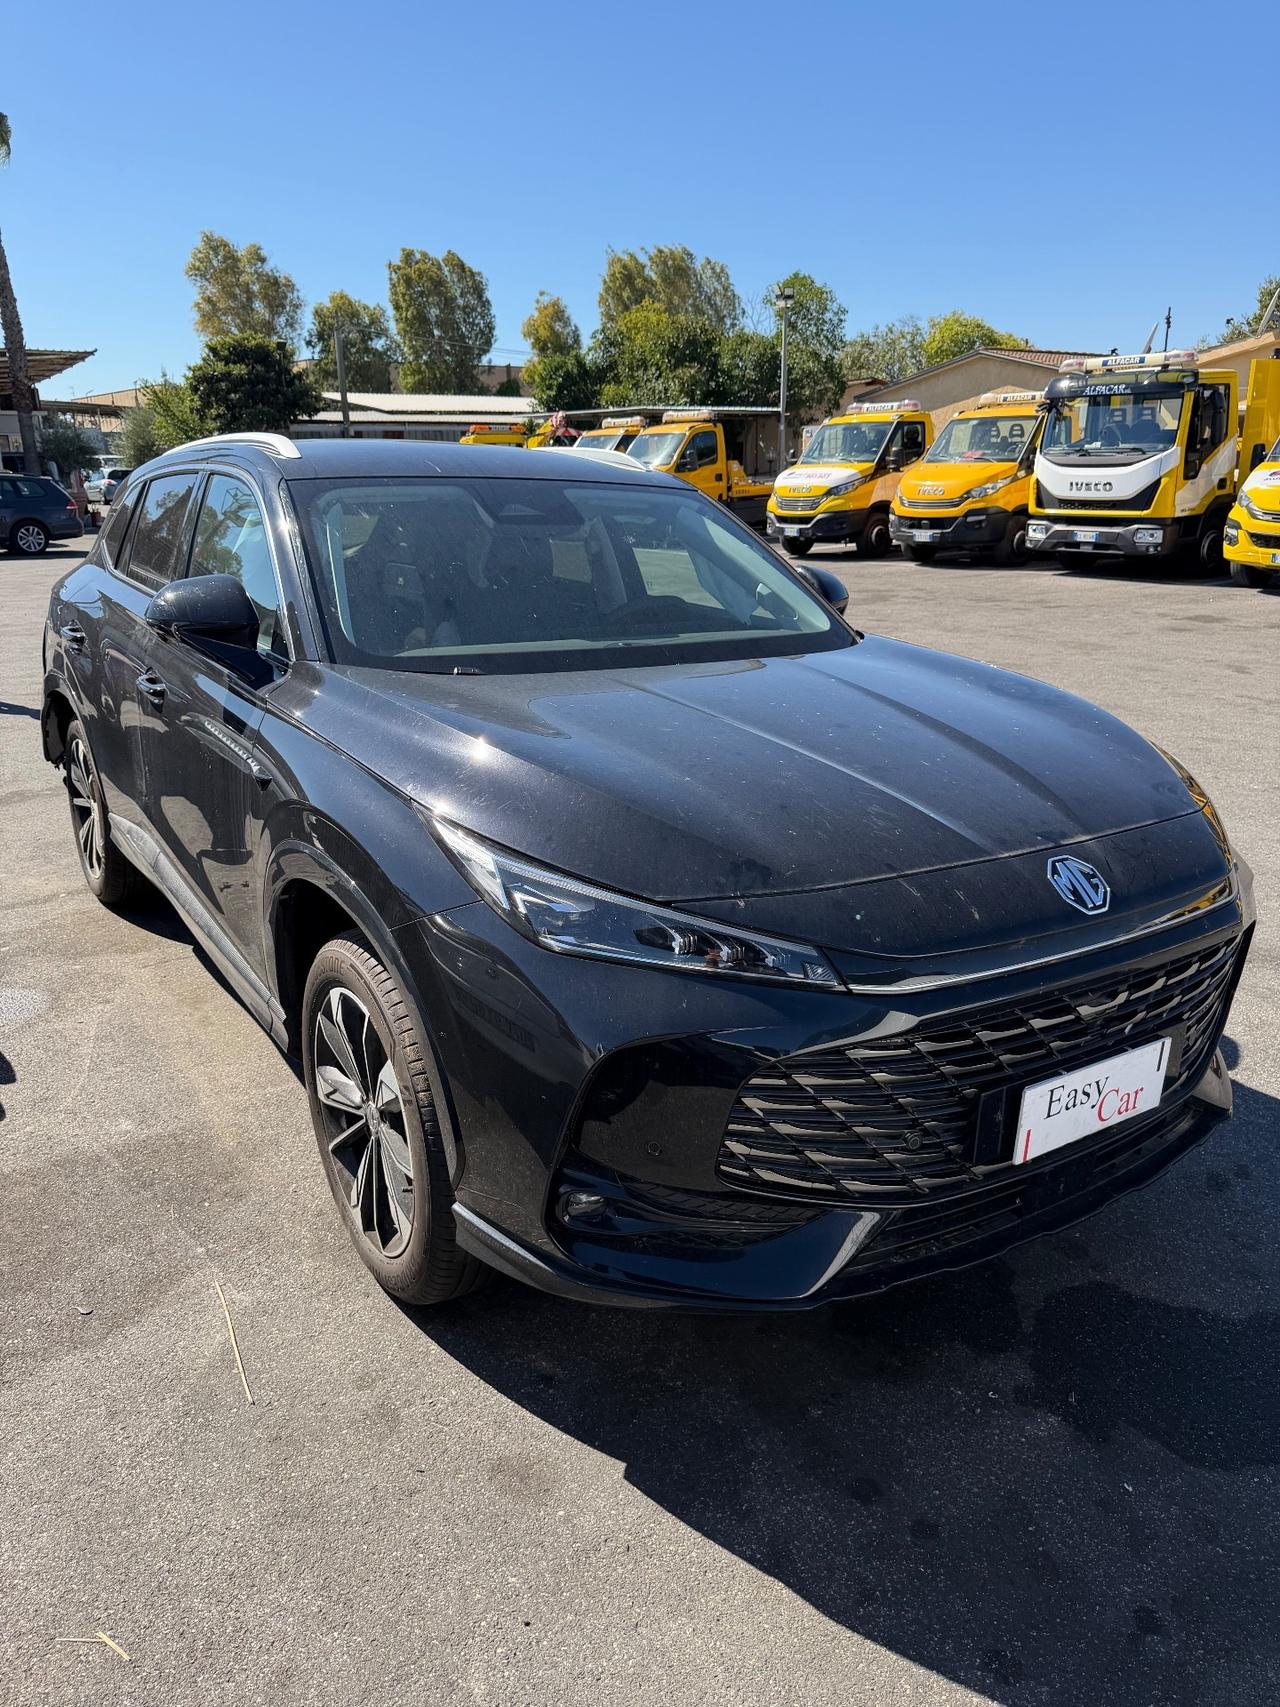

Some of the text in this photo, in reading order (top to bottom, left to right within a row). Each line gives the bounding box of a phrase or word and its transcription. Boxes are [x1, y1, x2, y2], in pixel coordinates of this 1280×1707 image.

[1107, 356, 1139, 365] ALFACAR
[1083, 384, 1126, 395] ALFACAR
[917, 486, 945, 496] IVECO
[1069, 481, 1113, 492] IVECO
[1054, 860, 1106, 908] MG
[1044, 1075, 1110, 1121] Easy
[1097, 1085, 1144, 1123] Car
